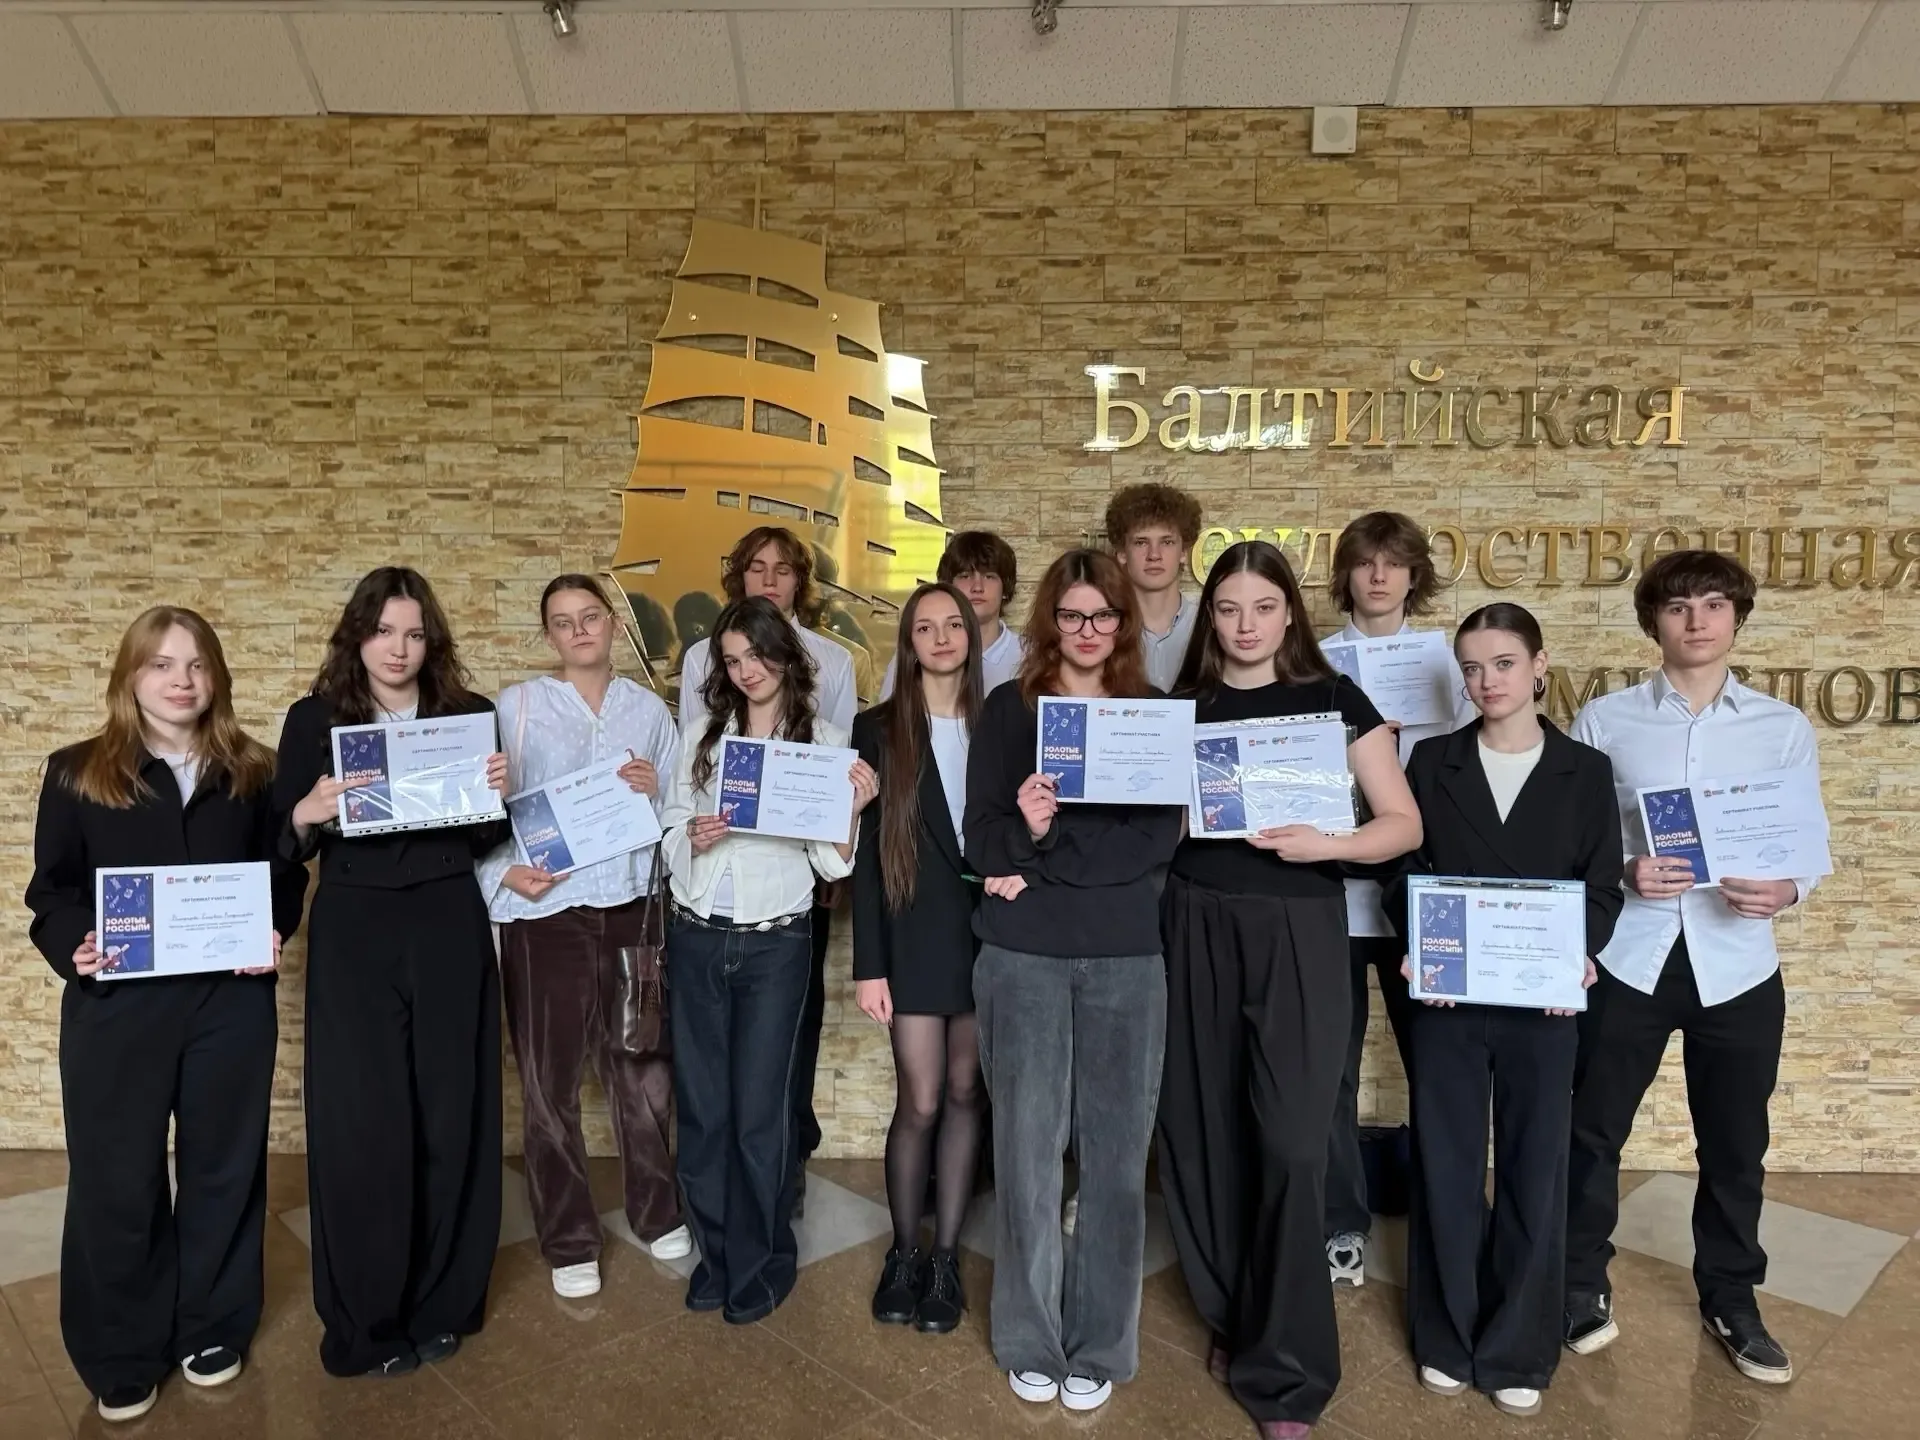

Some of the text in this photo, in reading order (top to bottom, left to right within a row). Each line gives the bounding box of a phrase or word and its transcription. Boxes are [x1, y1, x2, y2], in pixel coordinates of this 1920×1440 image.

[1084, 359, 1691, 451] Балтийская
[1044, 746, 1079, 754] ЗОЛОТЫЕ
[345, 768, 381, 778] ЗОЛОТЫЕ
[724, 779, 755, 787] ЗОЛОТЫЕ
[1202, 785, 1239, 794] РОССЫПИ
[1655, 831, 1692, 842] ЗОЛОТЫЕ
[1656, 838, 1698, 848] РОССЫПИ
[106, 916, 146, 925] ЗОЛОТЫЕ
[106, 924, 150, 932] РОССЫПИ
[1423, 945, 1462, 953] РОССЫПИ
